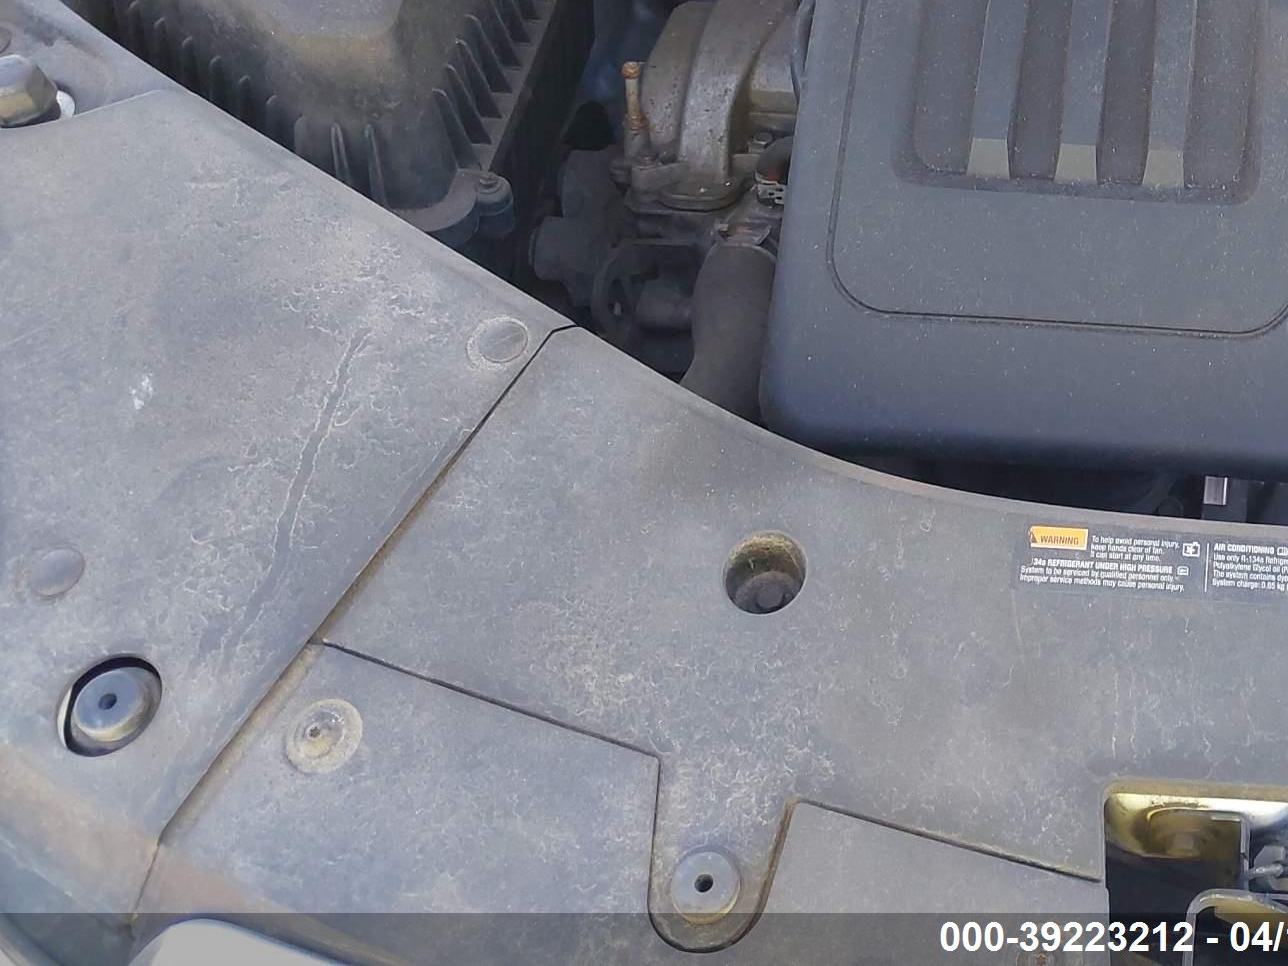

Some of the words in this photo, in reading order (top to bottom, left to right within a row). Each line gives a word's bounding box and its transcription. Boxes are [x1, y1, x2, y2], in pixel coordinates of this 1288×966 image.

[1040, 536, 1079, 545] WARNING
[1100, 536, 1114, 544] help
[1133, 538, 1160, 547] personal
[1214, 543, 1225, 551] AIR
[1227, 544, 1275, 554] CONDITIONING
[1133, 554, 1144, 562] any
[1214, 553, 1225, 561] Use
[1227, 555, 1239, 563] only
[1048, 559, 1094, 569] REFRIGERANT
[1095, 561, 1118, 570] UNDER
[1120, 563, 1136, 571] HIGH
[1138, 564, 1173, 574] PRESSURE
[1213, 562, 1251, 571] Polyalkylene
[1253, 564, 1271, 572] Glycol
[1091, 570, 1098, 578] by
[1101, 571, 1127, 580] qualified
[1128, 573, 1159, 581] personnel
[1213, 570, 1225, 578] The
[1226, 571, 1248, 580] system
[1249, 573, 1275, 581] contains
[1050, 576, 1072, 584] service
[1074, 578, 1101, 586] methods
[1103, 580, 1116, 588] may
[1138, 581, 1164, 589] personal
[1212, 578, 1235, 587] System
[1277, 583, 1284, 591] kg
